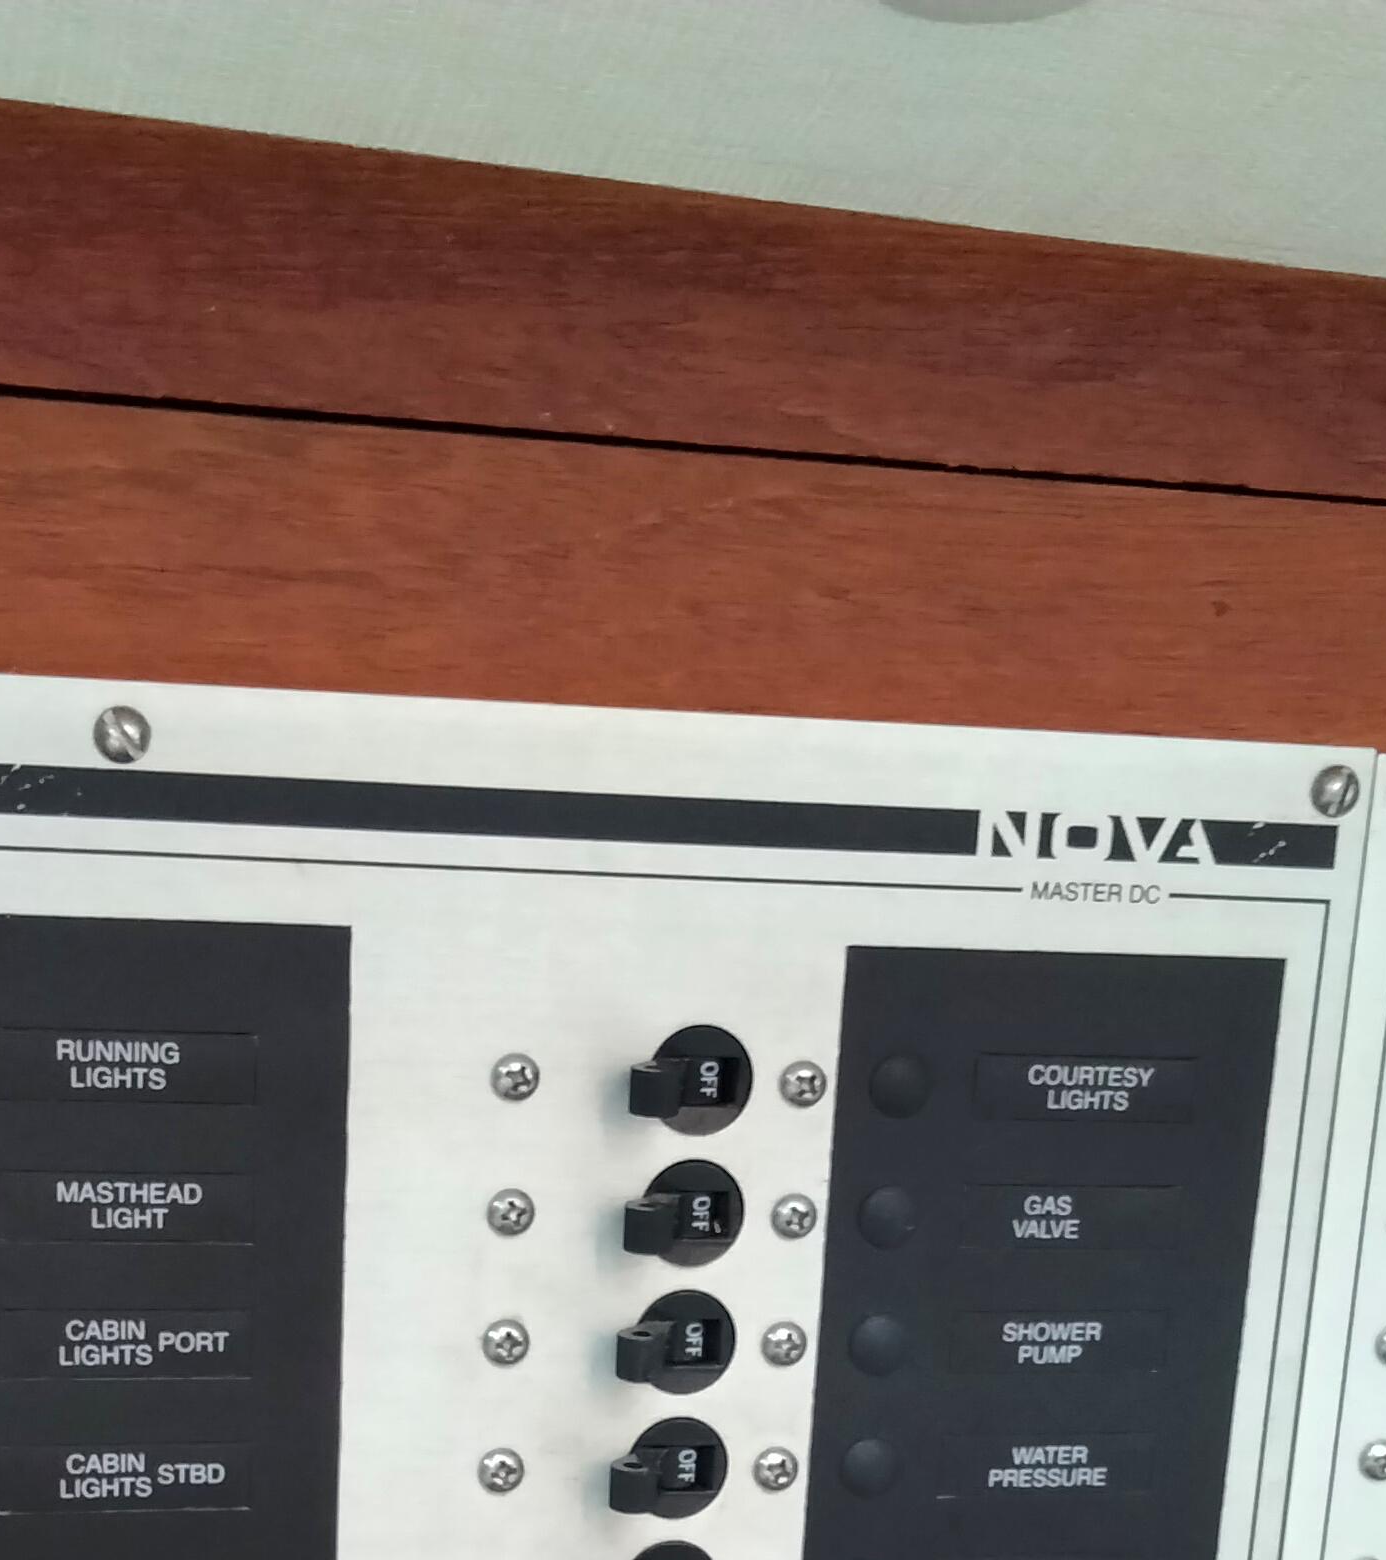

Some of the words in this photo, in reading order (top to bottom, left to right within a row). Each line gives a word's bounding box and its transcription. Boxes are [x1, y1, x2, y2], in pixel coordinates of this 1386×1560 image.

[976, 808, 1217, 866] NOVA
[1030, 881, 1123, 903] MASTER
[1129, 884, 1161, 905] DC
[55, 1038, 181, 1065] RUNNING
[70, 1066, 167, 1090] LIGHTS
[699, 1060, 720, 1098] OFF
[1027, 1063, 1156, 1088] COURTESY
[1046, 1089, 1130, 1111] LIGHTS
[55, 1180, 203, 1206] MASTHEAD
[691, 1195, 712, 1233] OFF
[1023, 1195, 1073, 1216] GAS
[90, 1207, 169, 1230] LIGHT
[1012, 1219, 1081, 1240] VALVE
[64, 1319, 146, 1342] CABIN
[158, 1330, 230, 1353] PORT
[684, 1321, 704, 1358] OFF
[1002, 1321, 1103, 1344] SHOWER
[58, 1344, 154, 1367] LIGHTS
[1017, 1345, 1083, 1365] PUMP
[65, 1452, 146, 1475] CABIN
[676, 1448, 698, 1483] OFF
[1012, 1445, 1089, 1466] WATER
[157, 1462, 226, 1486] STBD
[988, 1466, 1108, 1489] PRESSURE
[59, 1476, 153, 1499] LIGHTS
